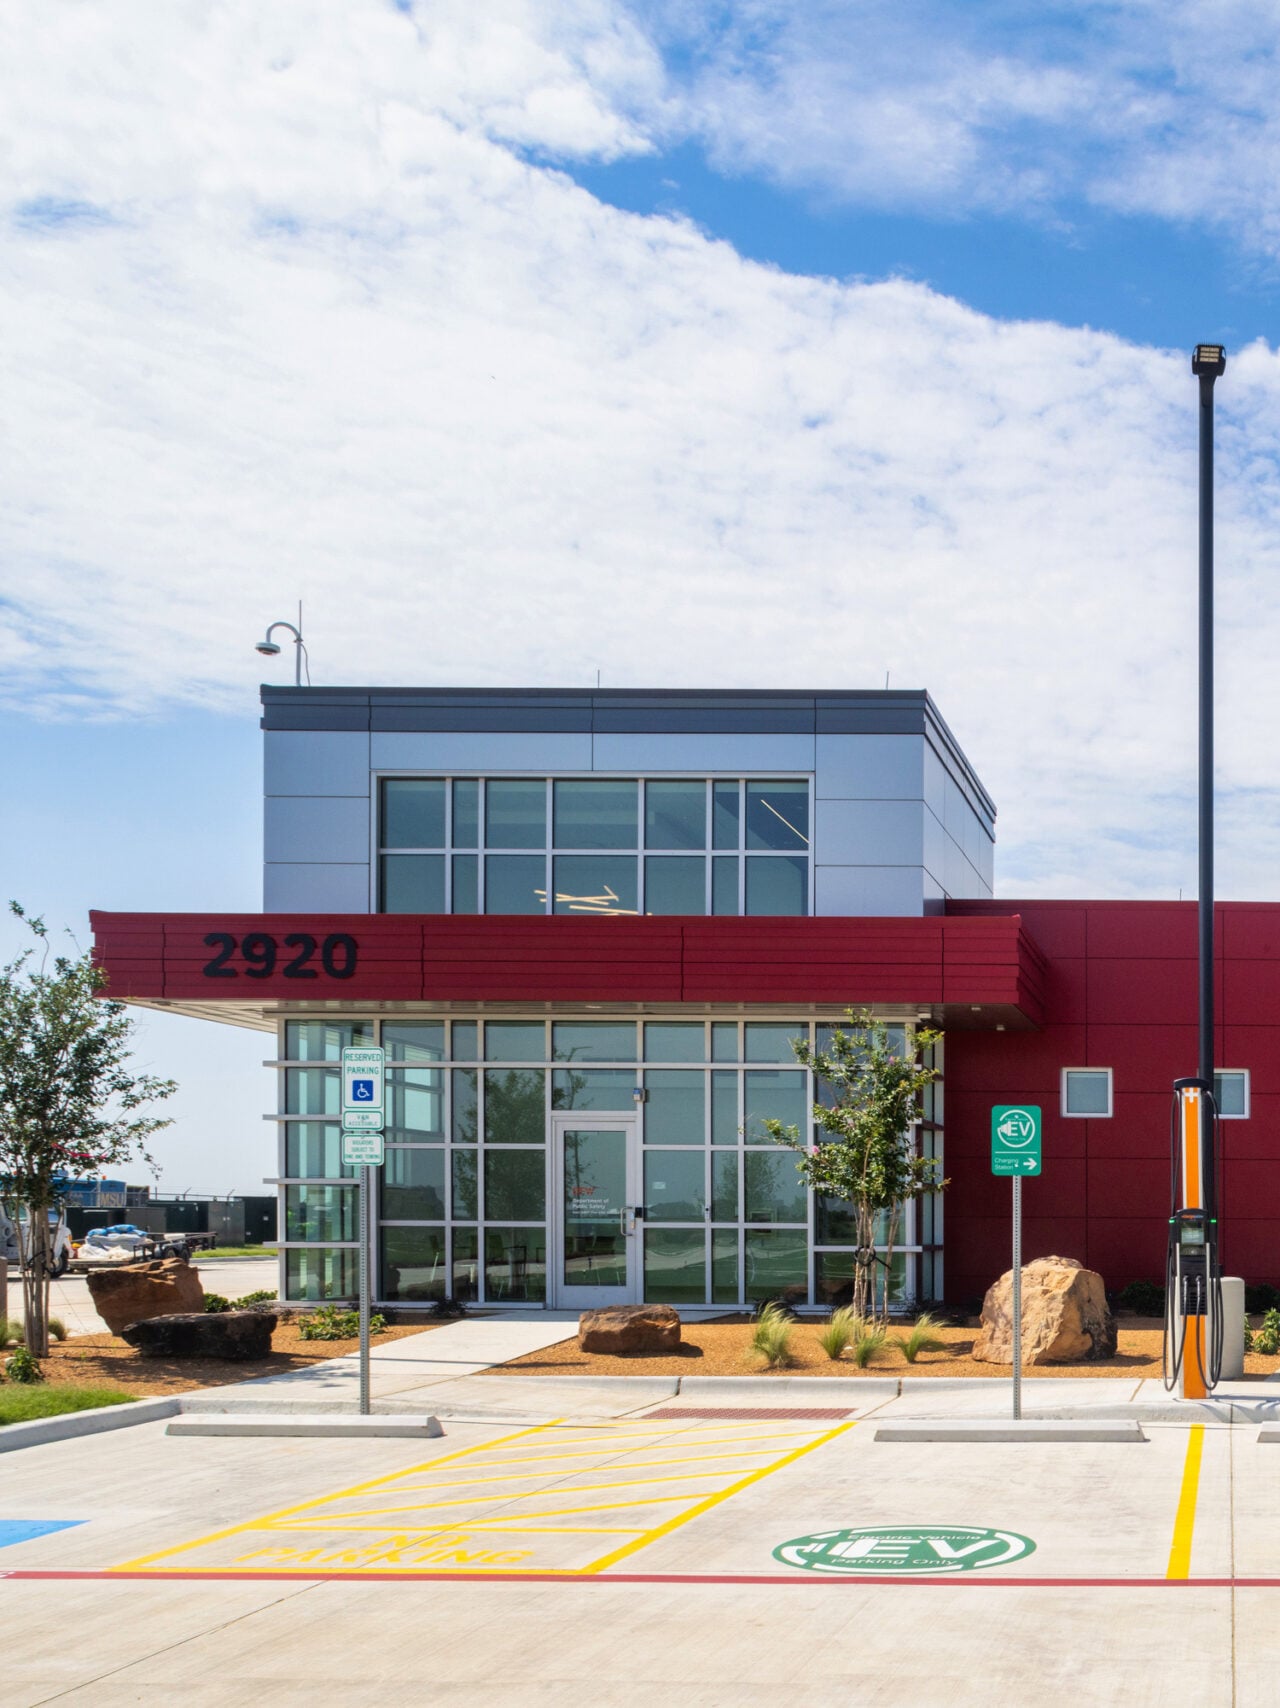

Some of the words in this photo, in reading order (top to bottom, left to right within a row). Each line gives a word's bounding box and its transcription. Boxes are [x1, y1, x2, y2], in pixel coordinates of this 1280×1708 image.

[203, 932, 359, 979] 2920
[347, 1067, 379, 1075] PARKING
[1006, 1121, 1031, 1136] EV
[994, 1157, 1019, 1165] Charging
[368, 1534, 472, 1548] NO
[231, 1547, 535, 1563] PARKING
[842, 1538, 1000, 1559] EV
[831, 1558, 905, 1566] Parking
[911, 1558, 959, 1566] Only
